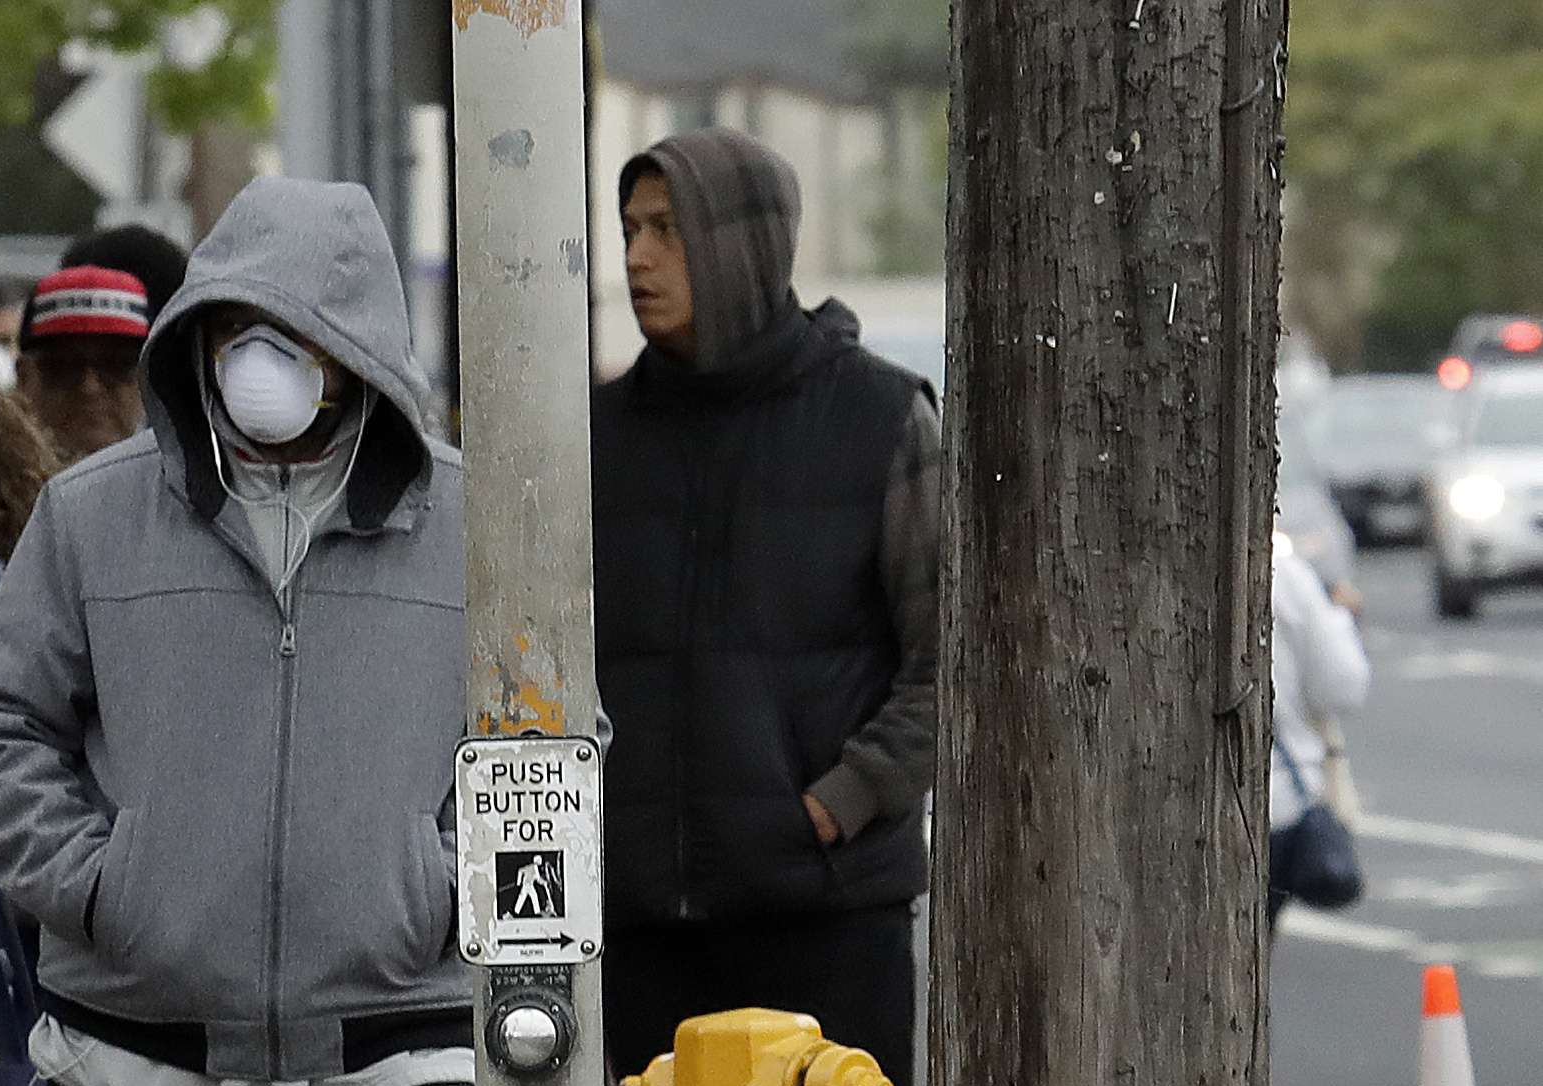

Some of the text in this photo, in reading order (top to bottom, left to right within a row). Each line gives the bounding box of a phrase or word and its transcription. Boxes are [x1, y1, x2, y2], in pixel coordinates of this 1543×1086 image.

[491, 762, 563, 785] PUSH
[475, 789, 581, 814] BUTTON
[503, 819, 554, 842] FOR
